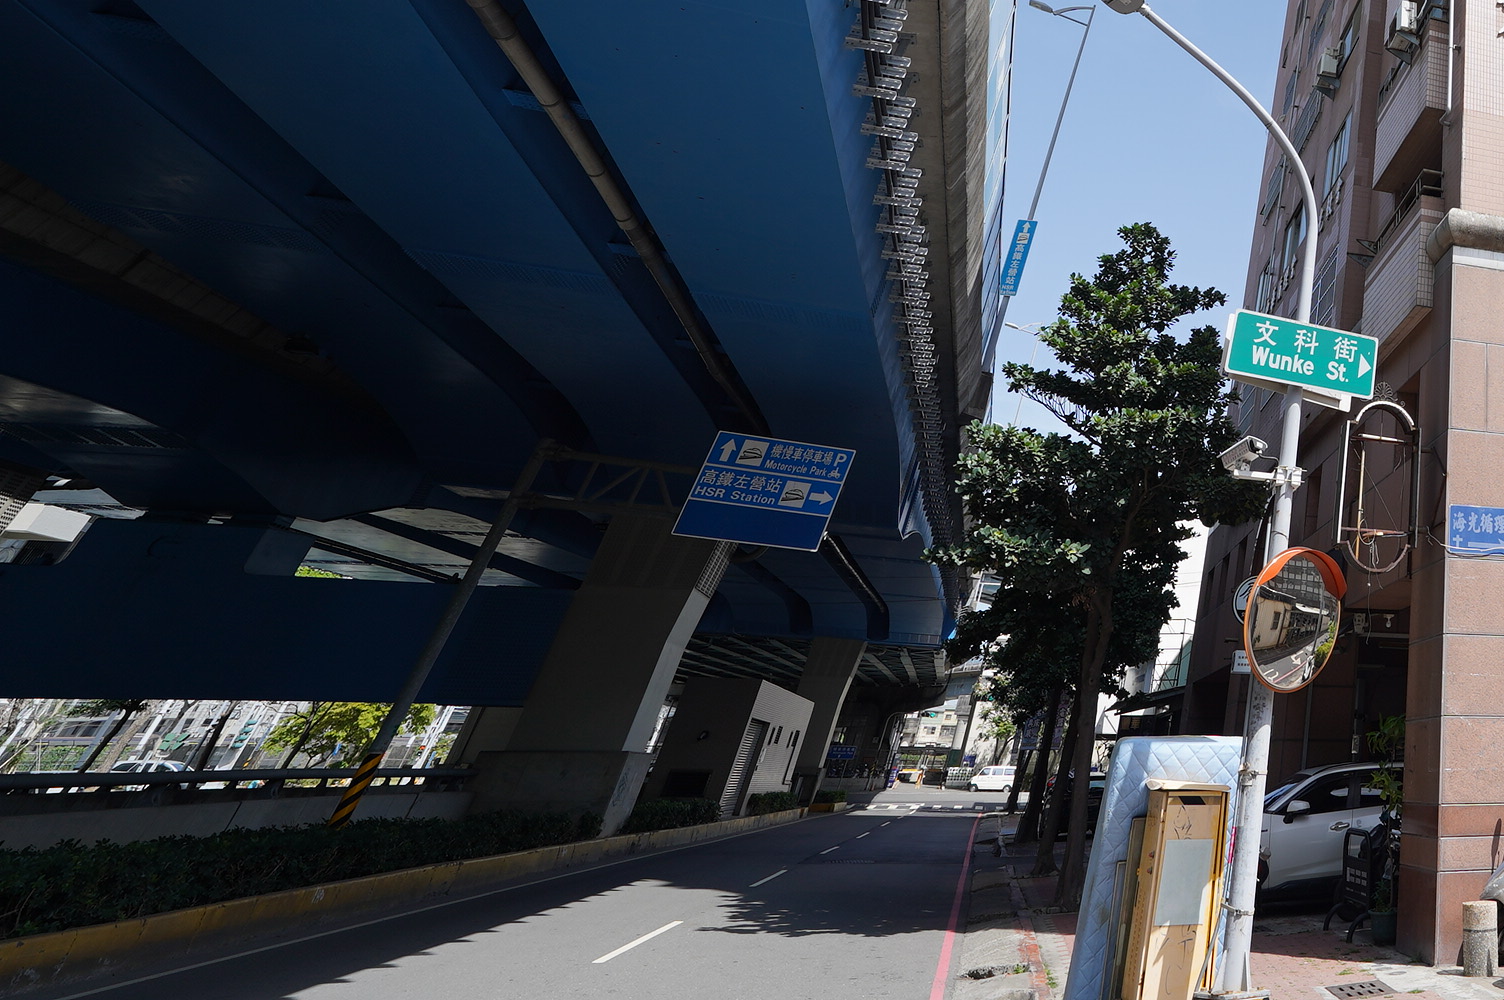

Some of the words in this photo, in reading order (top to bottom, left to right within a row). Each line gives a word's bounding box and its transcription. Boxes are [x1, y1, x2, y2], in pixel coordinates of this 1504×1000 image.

[1253, 320, 1358, 362] 文科街
[1252, 345, 1315, 375] Wunke
[1326, 361, 1349, 382] St.
[770, 443, 834, 466] 機慢車停車場
[764, 459, 808, 474] Motorcycle
[809, 465, 827, 477] Park
[699, 469, 783, 493] 高鐵左營站
[694, 486, 726, 498] HSR
[730, 490, 776, 505] Station
